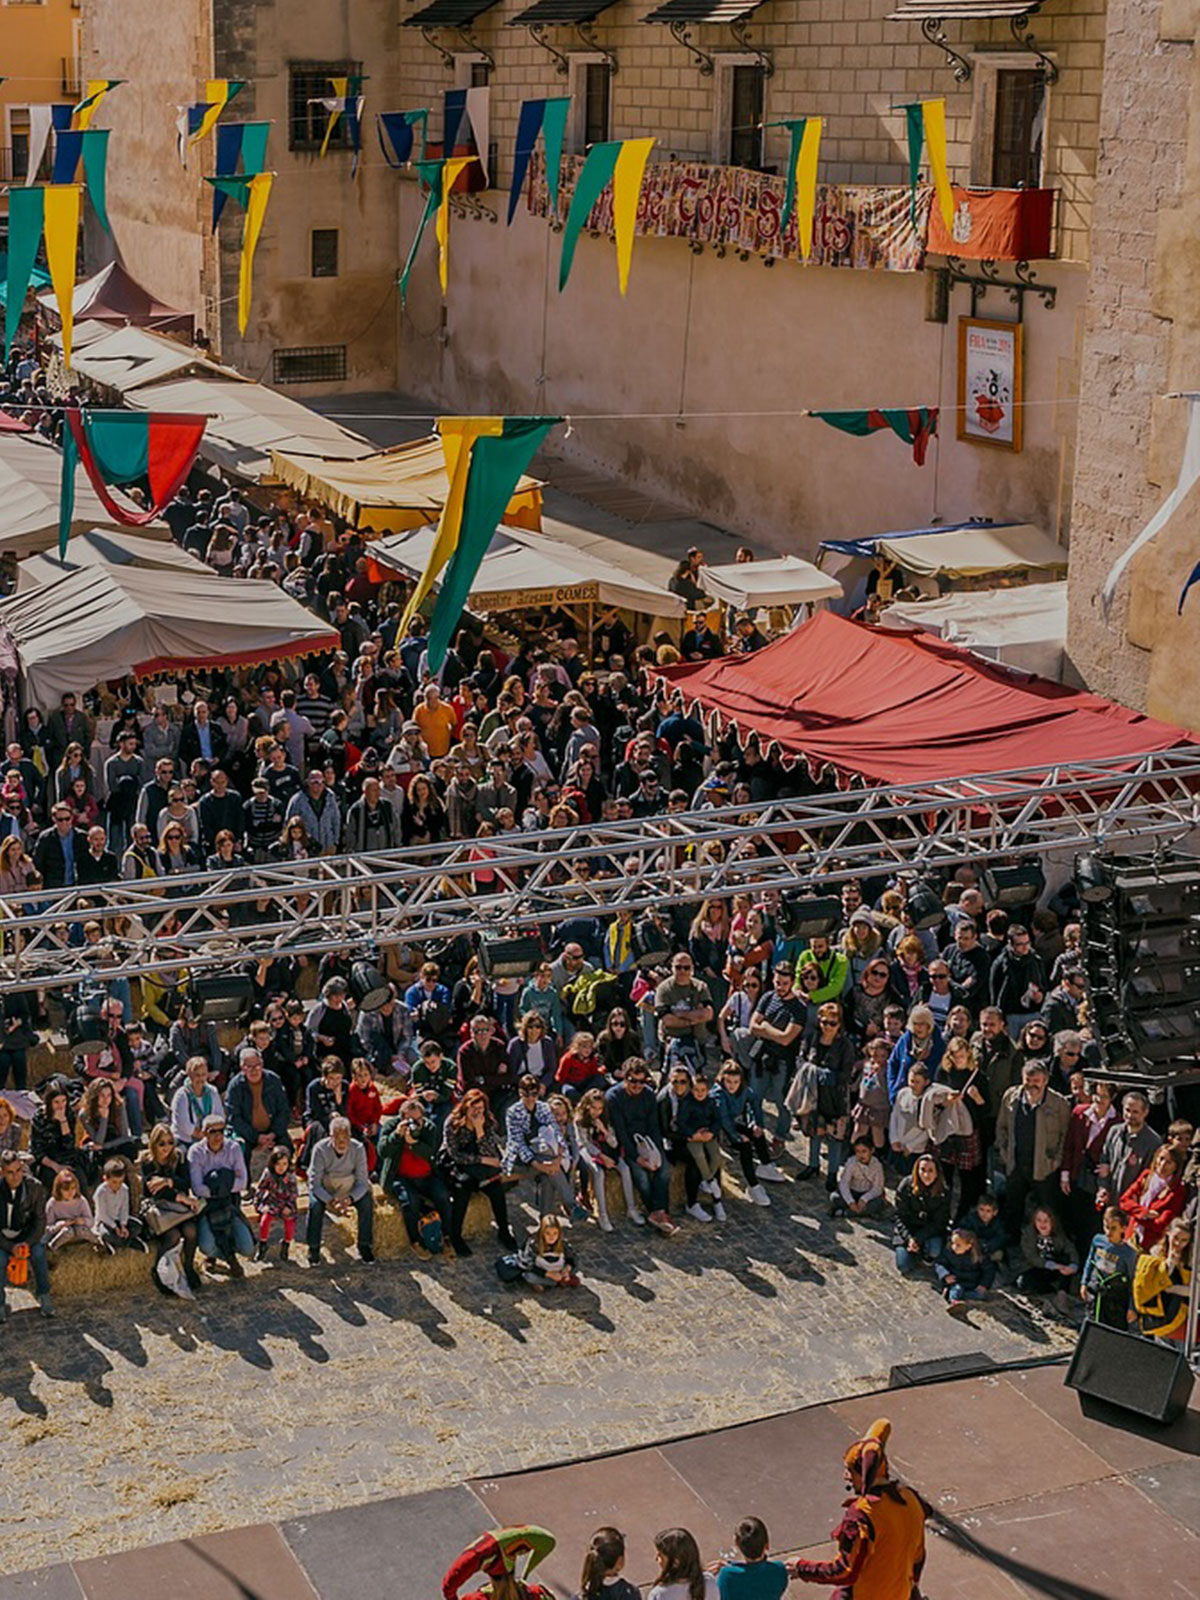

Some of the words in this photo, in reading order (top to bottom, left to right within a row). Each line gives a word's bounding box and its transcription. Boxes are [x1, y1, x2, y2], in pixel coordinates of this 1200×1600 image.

[678, 178, 742, 229] Tots
[756, 190, 850, 250] Sats
[556, 587, 597, 602] COMES
